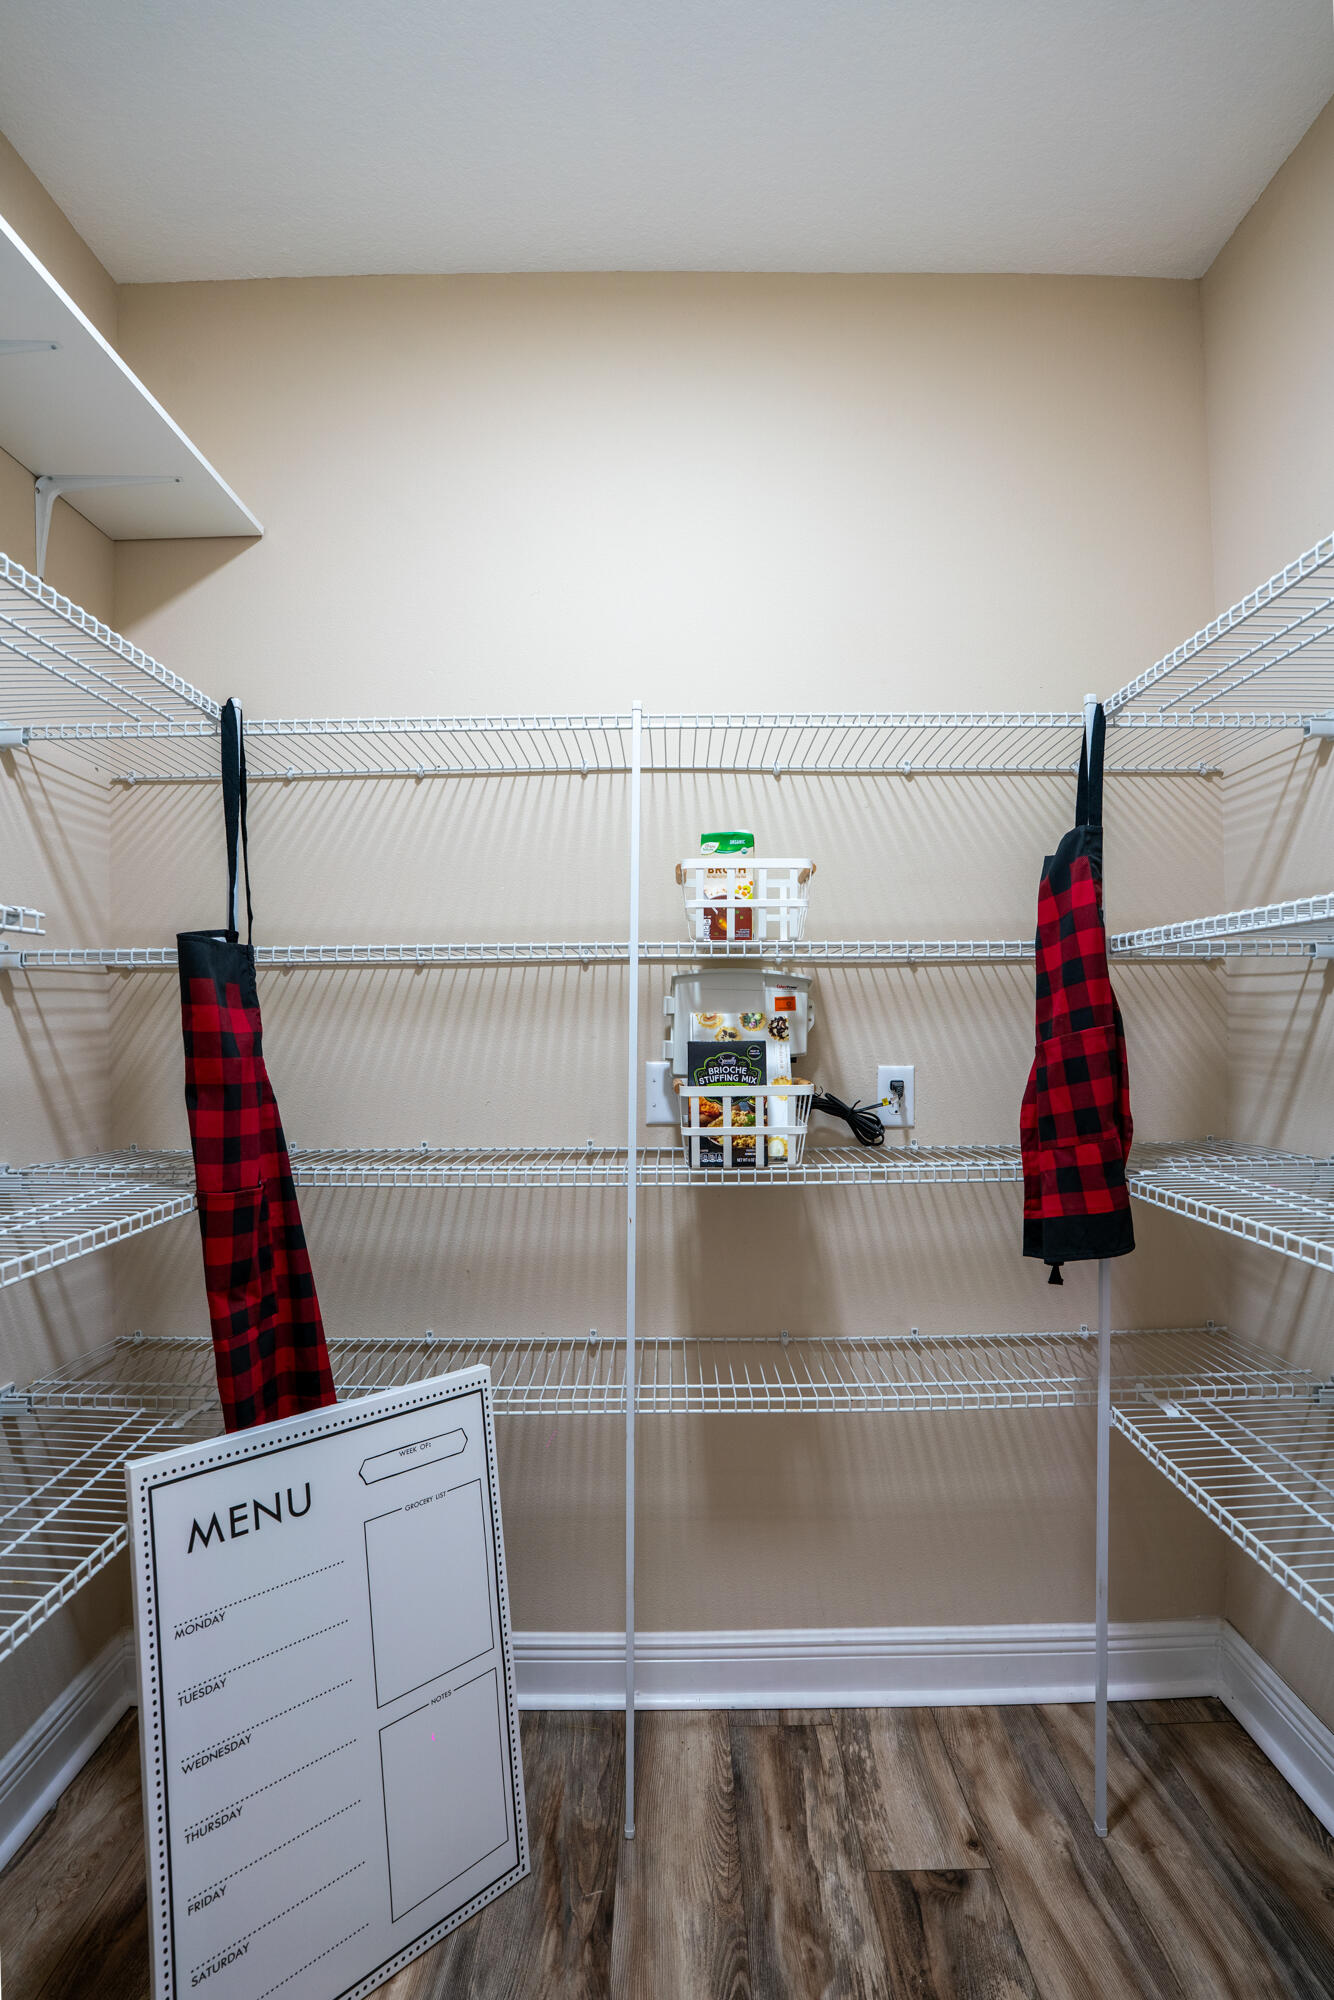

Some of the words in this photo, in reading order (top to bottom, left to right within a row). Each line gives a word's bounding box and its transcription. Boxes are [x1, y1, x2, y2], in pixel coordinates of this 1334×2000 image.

[699, 1074, 739, 1084] STUFFING
[742, 1075, 757, 1084] MIX
[708, 1066, 747, 1075] BRIOCHE
[398, 1446, 417, 1457] WEEK
[420, 1442, 432, 1451] OF:
[404, 1497, 433, 1512] GROCERY
[435, 1491, 447, 1500] LIST
[187, 1482, 312, 1554] MENU
[174, 1612, 226, 1640] MONDAY
[178, 1678, 227, 1708] TUESDAY
[430, 1689, 453, 1706] NOTES
[181, 1734, 252, 1775] WEDNESDAY
[184, 1806, 243, 1844] THURSDAY
[187, 1885, 227, 1916] FRIDAY
[191, 1943, 250, 1987] SATURDAY
